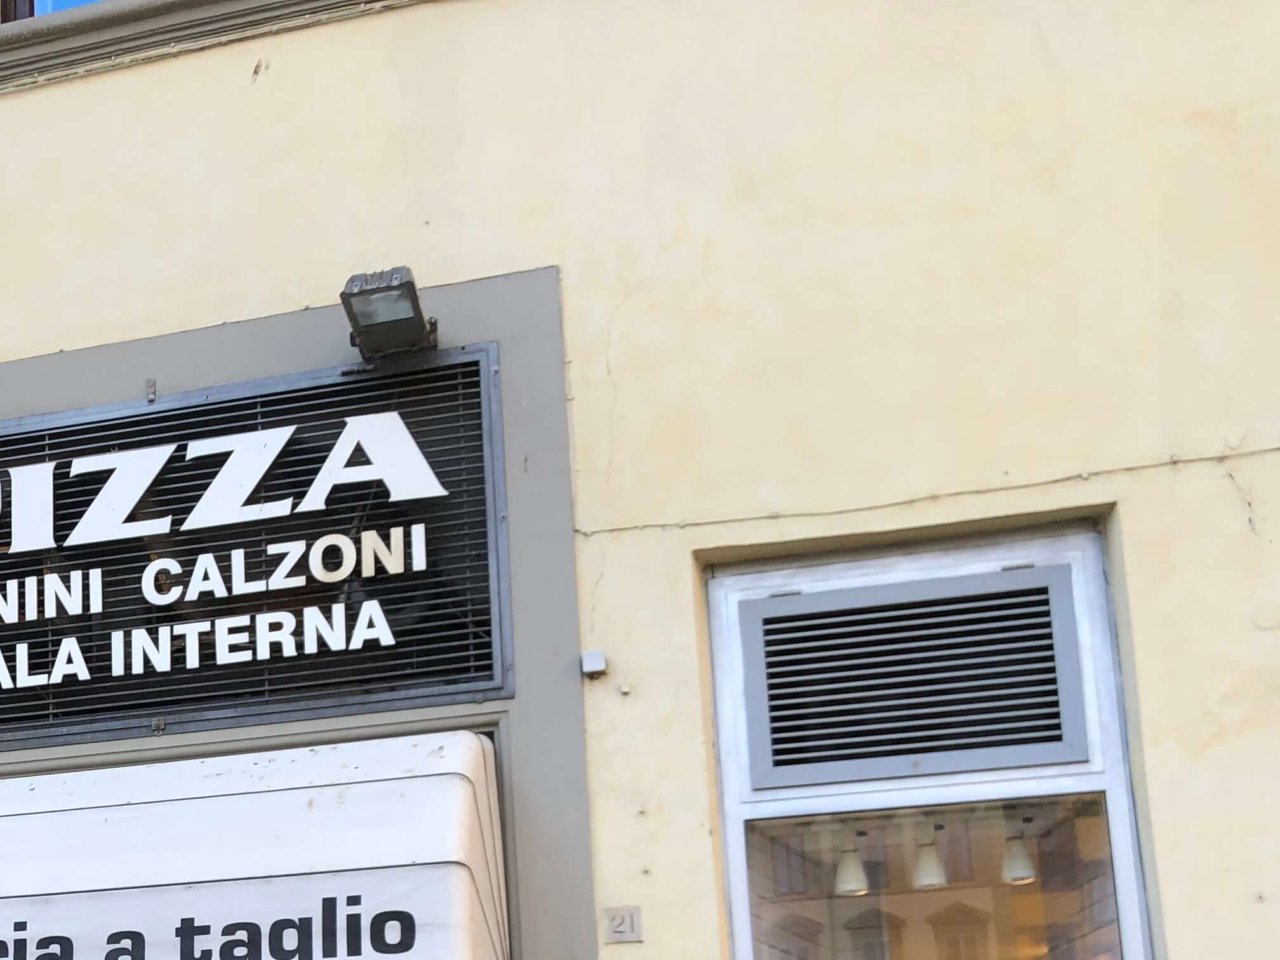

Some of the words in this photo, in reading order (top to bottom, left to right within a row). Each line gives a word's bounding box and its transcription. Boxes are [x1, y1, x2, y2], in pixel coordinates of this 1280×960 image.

[141, 523, 427, 606] CALZONI
[111, 600, 396, 676] INTERNA
[611, 913, 635, 934] 21
